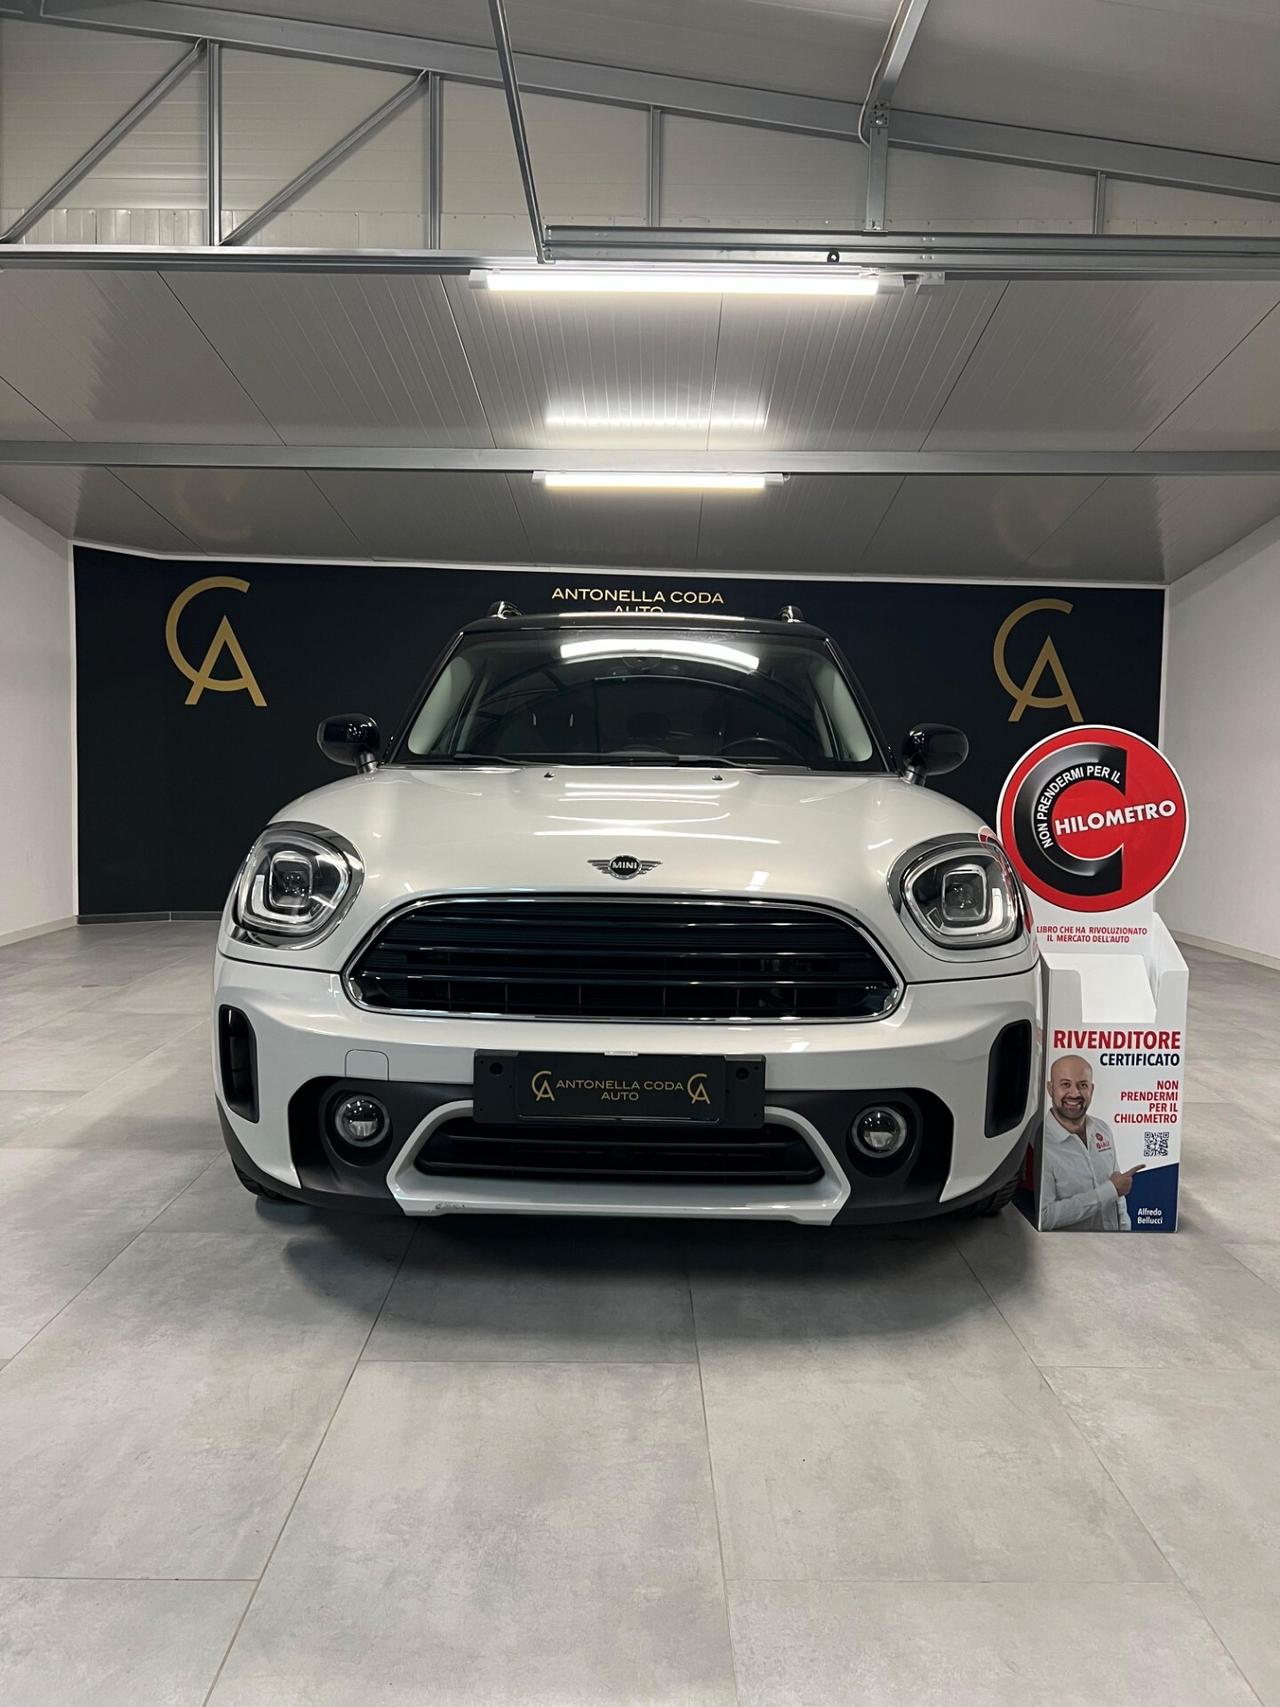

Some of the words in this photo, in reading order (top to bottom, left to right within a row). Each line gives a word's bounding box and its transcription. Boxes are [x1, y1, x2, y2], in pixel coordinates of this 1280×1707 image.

[552, 588, 666, 603] ANTONELLA
[670, 591, 724, 604] CODA
[1086, 765, 1111, 779] PER
[1110, 770, 1122, 784] IL
[1037, 766, 1085, 821] PRENDERMI
[1037, 822, 1054, 849] NON
[611, 861, 638, 869] MINI
[1036, 926, 1058, 934] LIBRO
[1059, 926, 1074, 934] CHE
[1075, 926, 1086, 934] HA
[1088, 926, 1148, 935] RIVOLUZIONATO
[1046, 934, 1054, 942] IL
[1056, 934, 1091, 942] MERCATO
[1092, 934, 1130, 943] DELL'AUTO
[1053, 1030, 1181, 1049] RIVENDITORE
[1100, 1053, 1180, 1066] CERTIFICATO
[556, 1079, 640, 1091] ANTONELLA
[643, 1081, 684, 1091] CODA
[1156, 1080, 1179, 1090] NON
[601, 1091, 639, 1101] AUTO
[1120, 1091, 1178, 1101] PRENDERMI
[1149, 1102, 1167, 1112] PER
[1169, 1102, 1178, 1112] IL
[1113, 1113, 1178, 1124] CHILOMETRO
[1137, 1207, 1162, 1217] Alfredo
[1137, 1216, 1163, 1225] Bellucci
